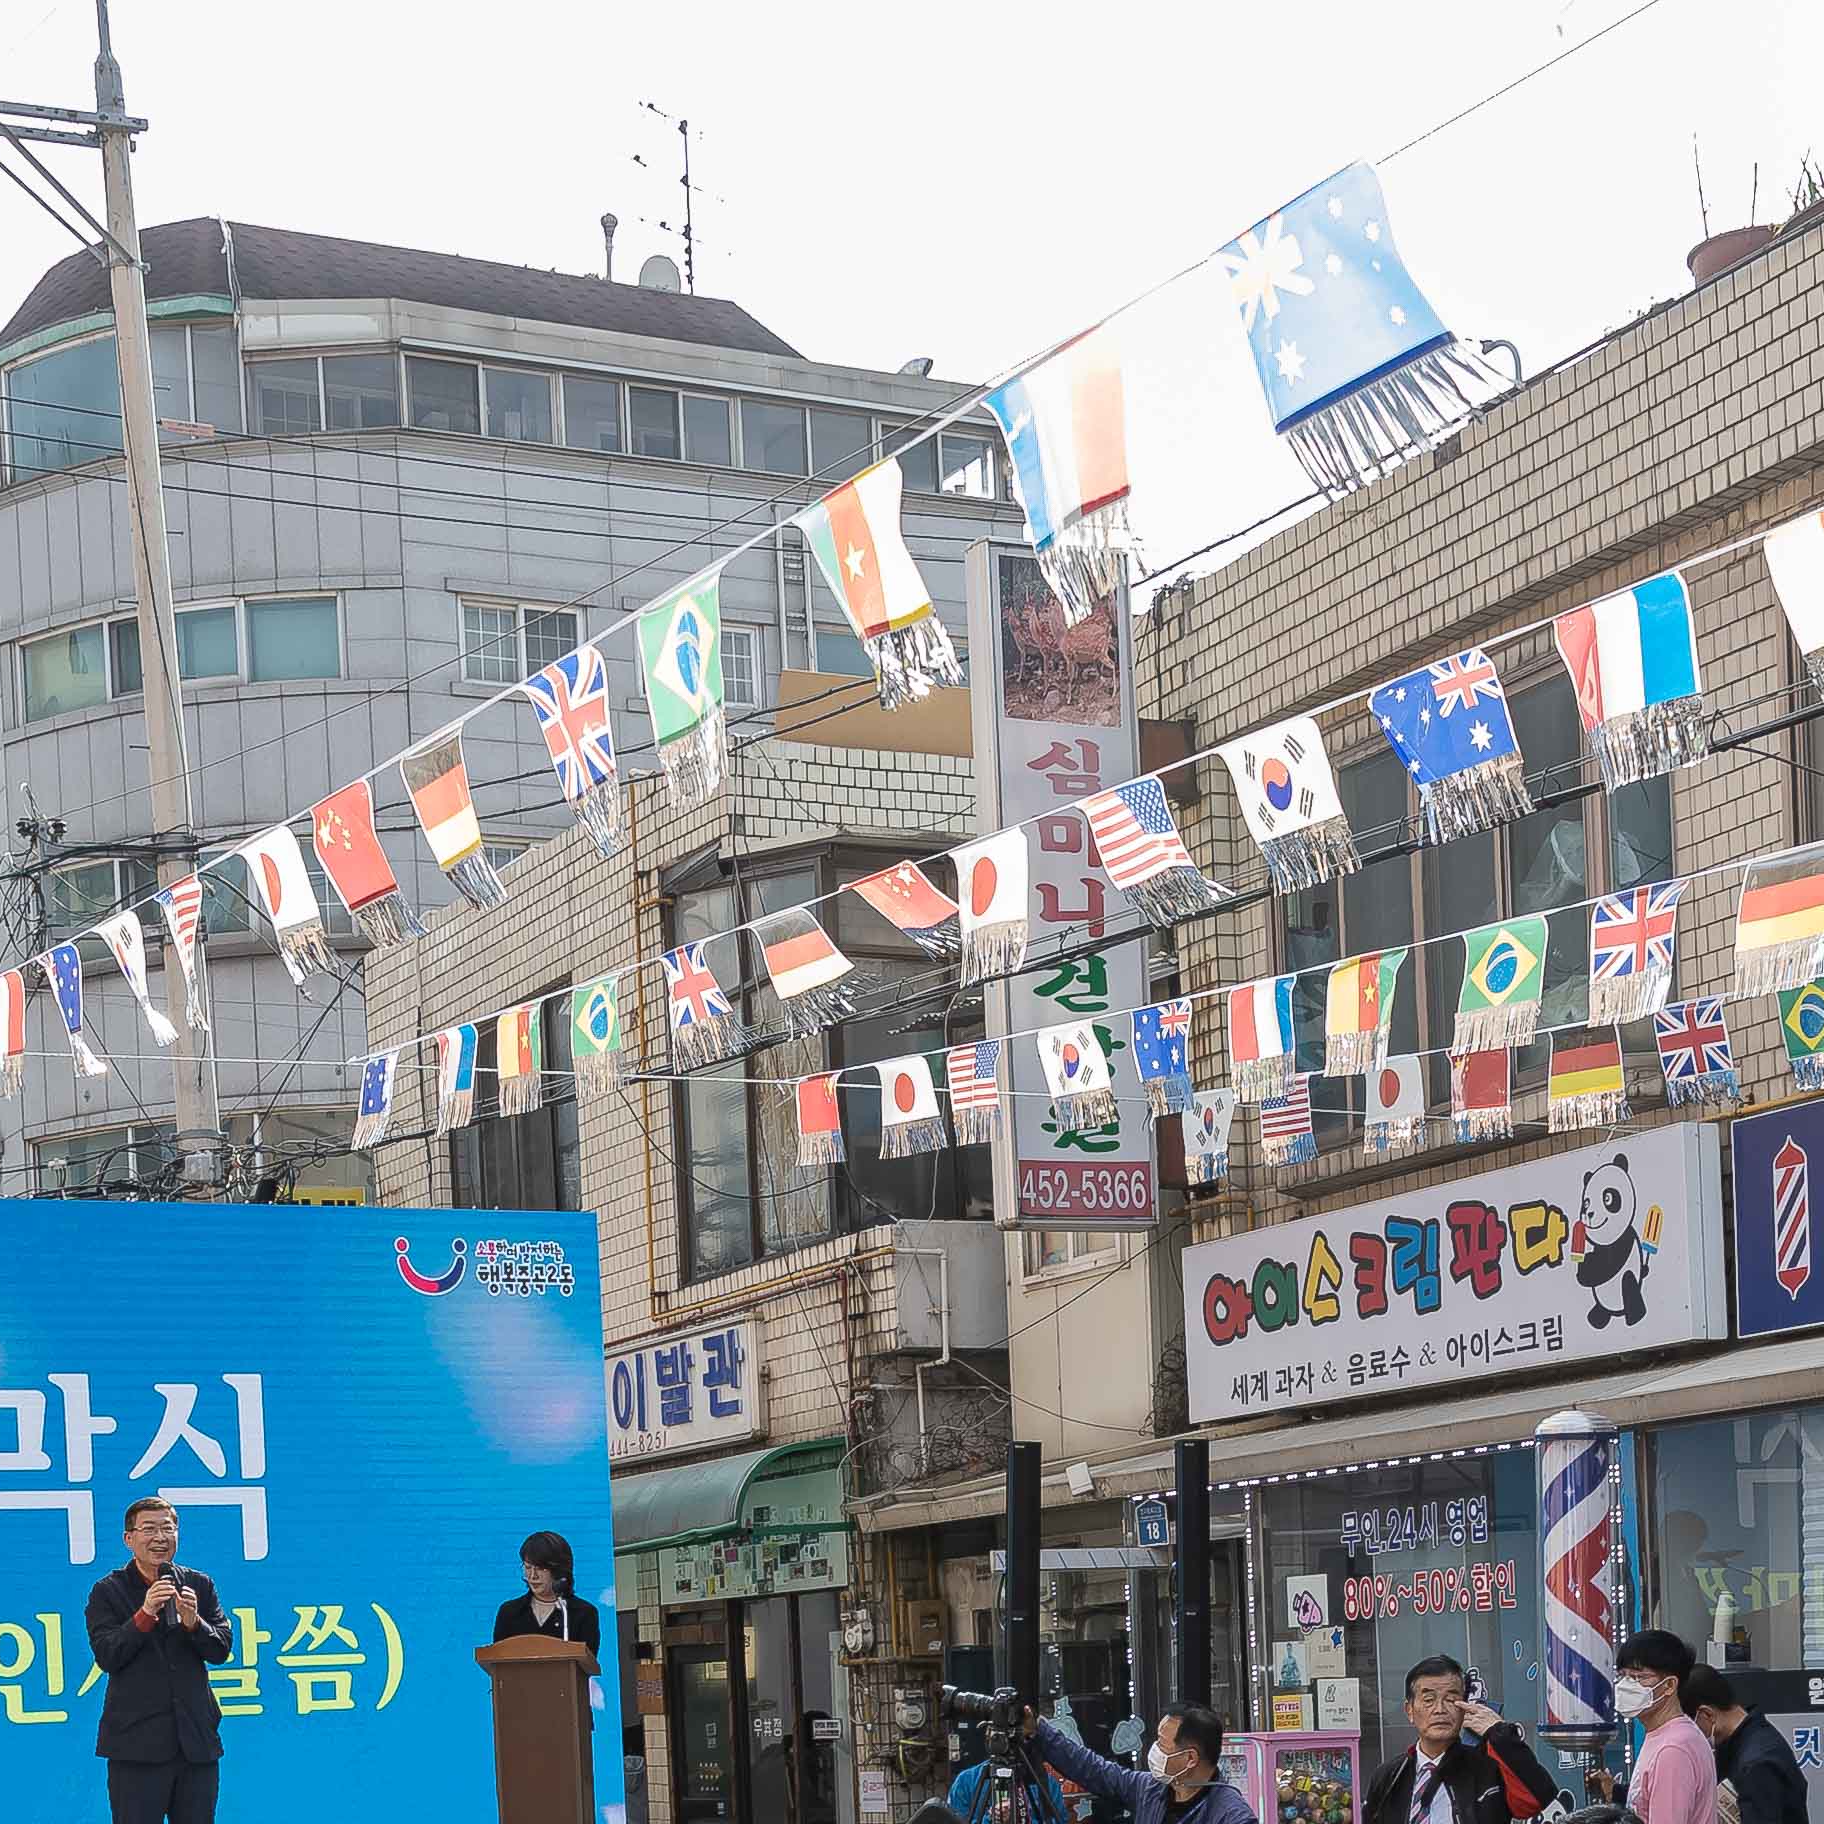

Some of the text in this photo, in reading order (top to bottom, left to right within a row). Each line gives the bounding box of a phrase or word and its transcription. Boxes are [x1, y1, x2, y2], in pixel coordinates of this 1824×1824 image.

[1021, 1165, 1147, 1216] 452-5366
[477, 1240, 563, 1263] 소통하며 발전하는
[477, 1261, 574, 1295] 행복중곡2동
[1202, 1198, 1569, 1347] 아이스크림판다
[612, 1328, 745, 1432] 이발관
[1231, 1314, 1565, 1406] 세계 과자 & 음료수 & 아이스크림
[1146, 1521, 1160, 1540] 18
[1340, 1495, 1488, 1558] 무인.24시 영업
